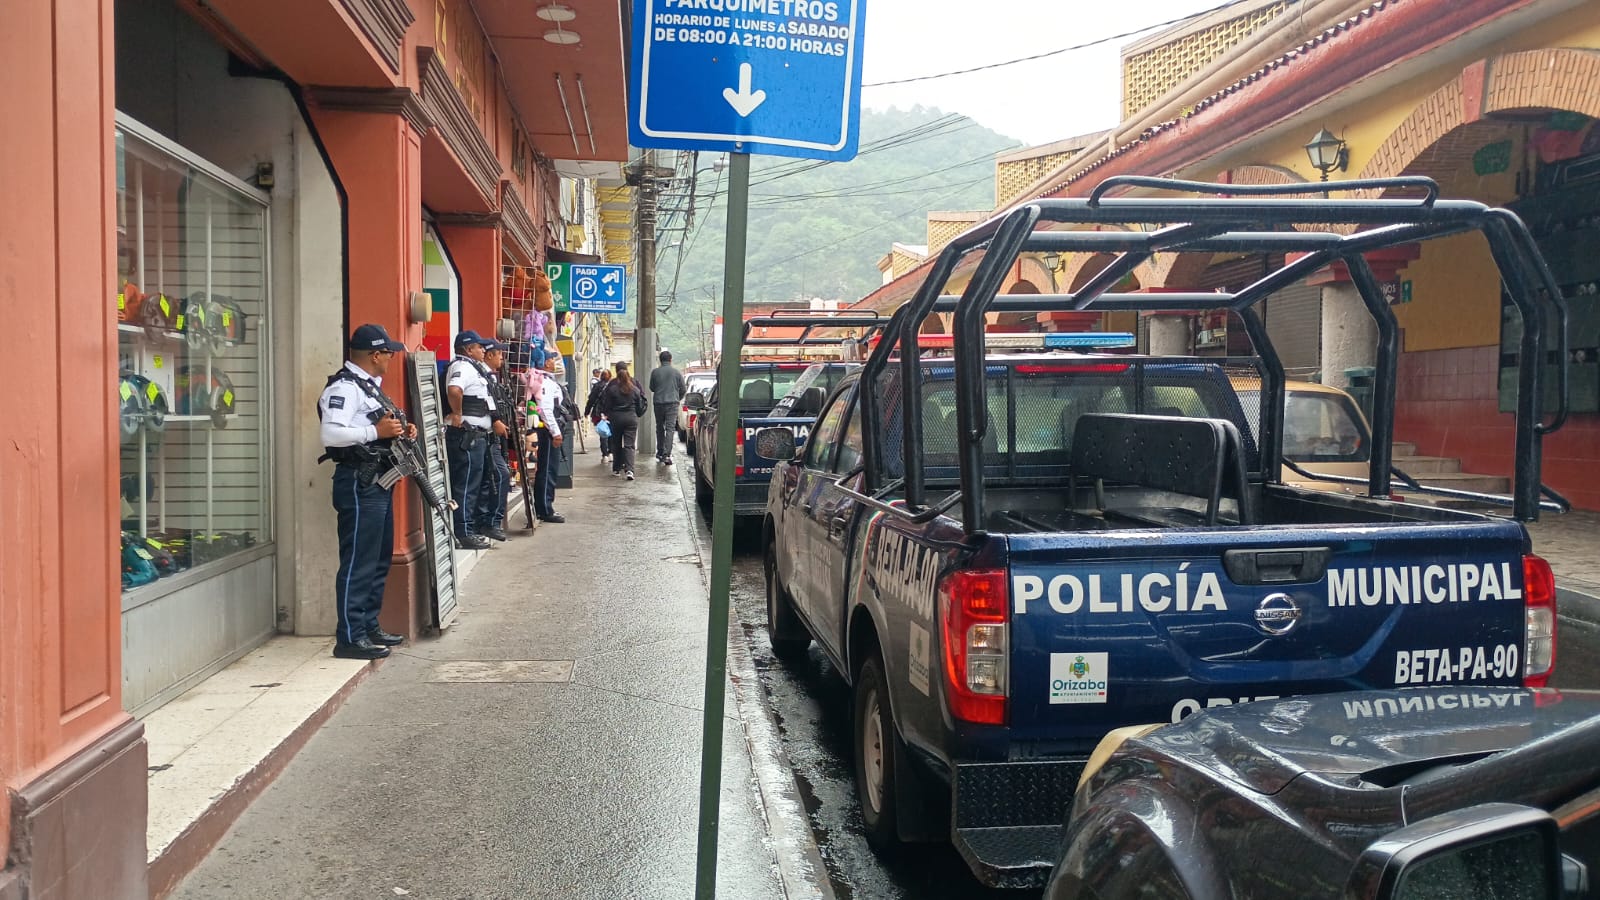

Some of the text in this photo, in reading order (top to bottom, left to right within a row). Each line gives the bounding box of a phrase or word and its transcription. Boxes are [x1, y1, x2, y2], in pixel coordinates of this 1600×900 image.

[655, 13, 849, 40] HORARIO DE LUNES A SABADO
[654, 27, 845, 57] DE 08:00 A 21:00 HORAS
[575, 268, 598, 276] PAGO
[875, 526, 939, 620] BETA-PA-90
[1013, 562, 1522, 614] POLICÍA MUNICIPAL
[1394, 643, 1519, 684] BETA-PA-90
[1052, 679, 1106, 691] Orizaba
